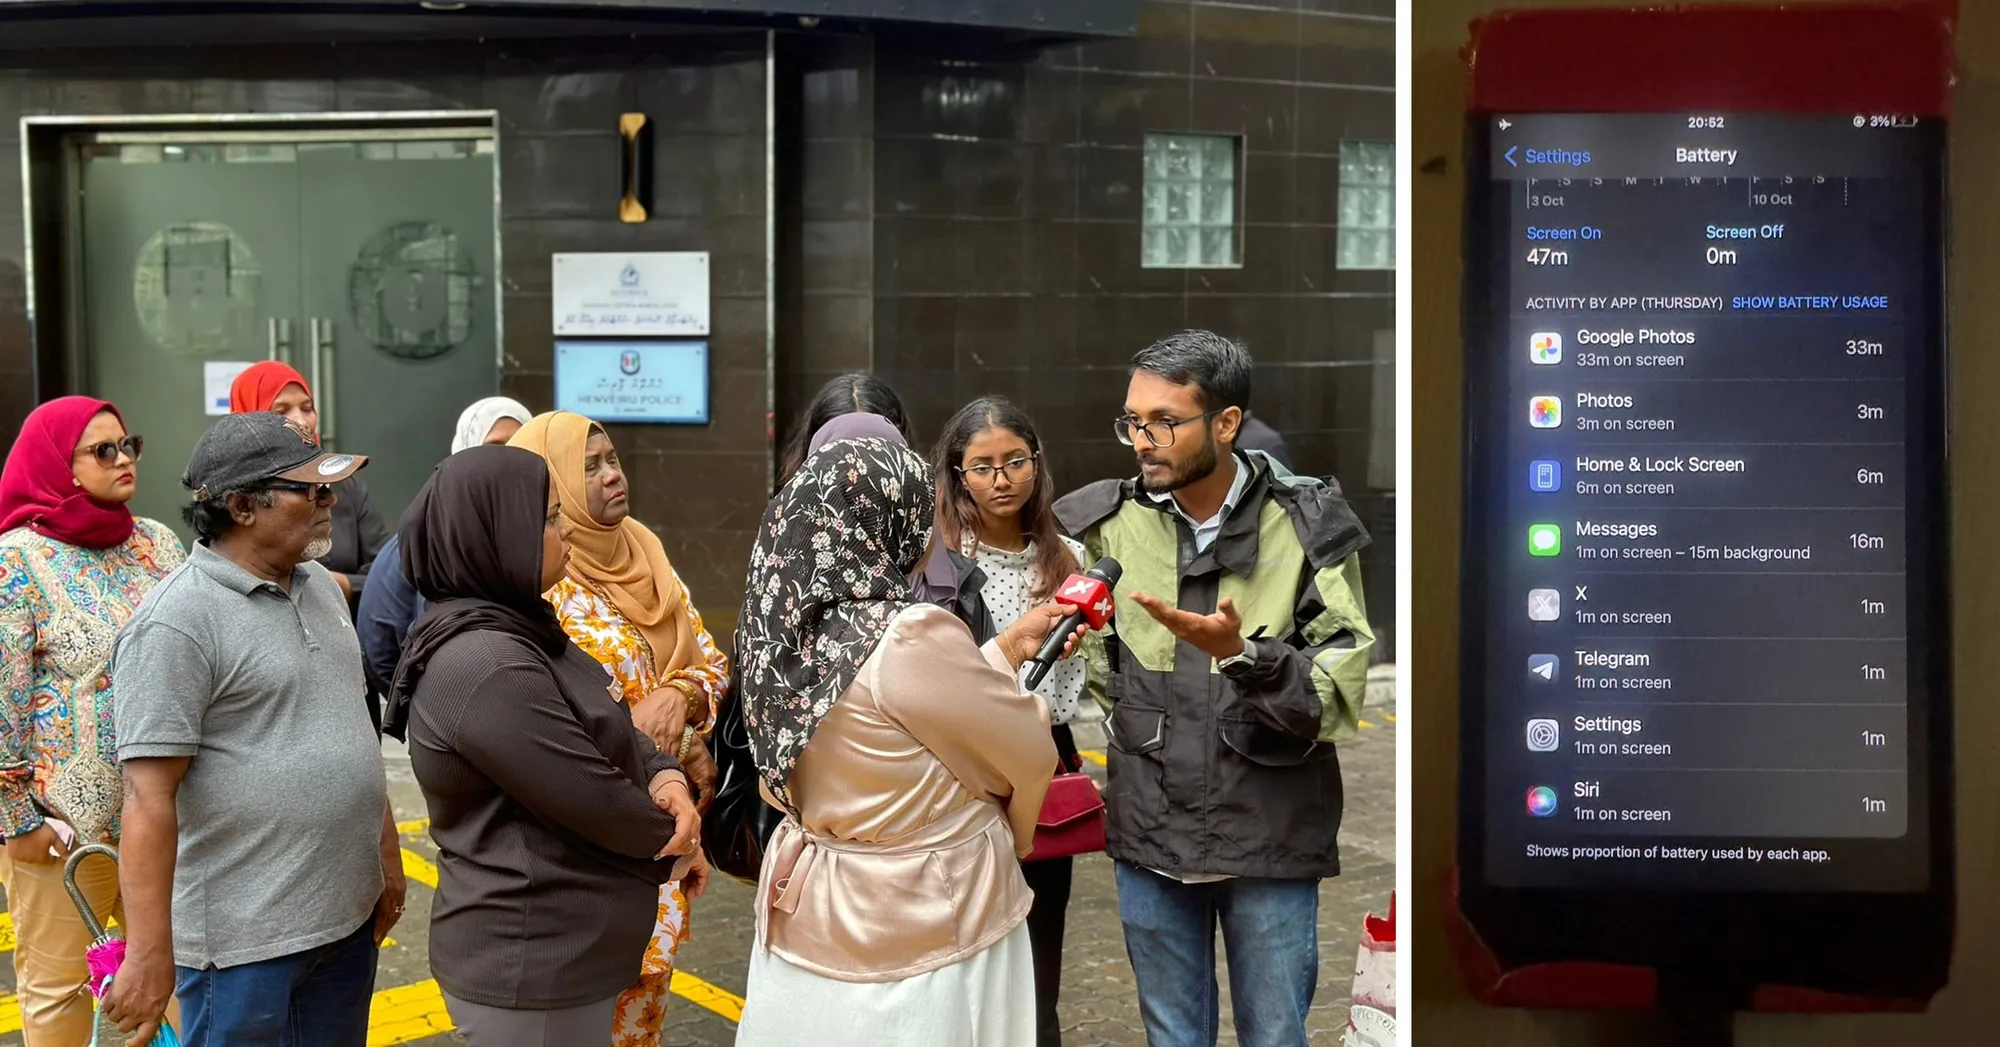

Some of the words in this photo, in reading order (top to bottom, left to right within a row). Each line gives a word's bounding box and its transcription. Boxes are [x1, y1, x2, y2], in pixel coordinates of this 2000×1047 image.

[1688, 116, 1724, 129] 20:52
[1870, 114, 1890, 127] 3%
[1525, 148, 1591, 167] Settings
[1676, 147, 1738, 166] Battery
[1531, 195, 1540, 207] 3
[1542, 195, 1564, 207] Oct
[1752, 194, 1768, 205] 10
[1770, 193, 1793, 205] Oct
[1526, 226, 1577, 240] Screen
[1580, 226, 1602, 240] On
[1706, 225, 1757, 239] Screen
[1760, 224, 1784, 239] Off
[1526, 247, 1568, 266] 47m
[1706, 246, 1737, 265] 0m
[1525, 297, 1586, 310] ACTIVITY
[1589, 296, 1608, 309] BY
[1610, 297, 1638, 309] APP
[1641, 296, 1723, 312] (THURSDAY)
[1732, 296, 1775, 309] SHOW
[1778, 295, 1839, 309] BATTERY
[1842, 295, 1888, 309] USAGE
[1577, 328, 1635, 348] Google
[1638, 328, 1695, 344] Photos
[1846, 339, 1883, 355] 33m
[1576, 352, 1610, 367] 33m
[1613, 355, 1632, 367] on
[1635, 355, 1684, 366] screen
[640, 394, 683, 405] POLICE
[1577, 392, 1633, 408] Photos
[1857, 403, 1883, 420] 3m
[1576, 416, 1600, 431] 3m
[1603, 419, 1622, 431] on
[1625, 419, 1675, 430] screen
[1576, 456, 1625, 472] Home
[1628, 456, 1642, 472] &
[1645, 456, 1685, 472] Lock
[1688, 456, 1745, 472] Screen
[1857, 468, 1884, 484] 6m
[1576, 480, 1599, 495] 6m
[1603, 483, 1622, 494] on
[1625, 483, 1675, 494] screen
[1575, 520, 1658, 540] Messages
[1849, 533, 1884, 549] 16m
[1575, 545, 1596, 559] 1m
[1600, 547, 1619, 559] on
[1622, 548, 1672, 559] screen
[1689, 545, 1720, 559] 15m
[1723, 545, 1811, 562] background
[1575, 585, 1588, 601] X
[1861, 598, 1885, 614] 1m
[1575, 609, 1596, 624] 1m
[1599, 612, 1618, 624] on
[1622, 612, 1672, 624] screen
[1574, 650, 1650, 670] Telegram
[1861, 664, 1885, 680] 1m
[1574, 675, 1596, 689] 1m
[1599, 677, 1618, 689] on
[1621, 678, 1672, 689] screen
[1574, 715, 1642, 735] Settings
[1861, 730, 1886, 746] 1m
[1574, 740, 1595, 755] 1m
[1598, 743, 1618, 755] on
[1621, 743, 1671, 755] screen
[1574, 780, 1600, 798] Siri
[1862, 796, 1886, 812] 1m
[1573, 806, 1595, 820] 1m
[1598, 809, 1617, 821] on
[1621, 809, 1671, 821] screen
[1526, 844, 1570, 857] Shows
[1572, 845, 1641, 861] proportion
[1643, 845, 1658, 859] of
[1661, 845, 1709, 862] battery
[1711, 846, 1744, 860] used
[1747, 846, 1764, 862] by
[1766, 847, 1799, 860] each
[1802, 850, 1831, 863] app.
[1376, 1015, 1396, 1037] POL
